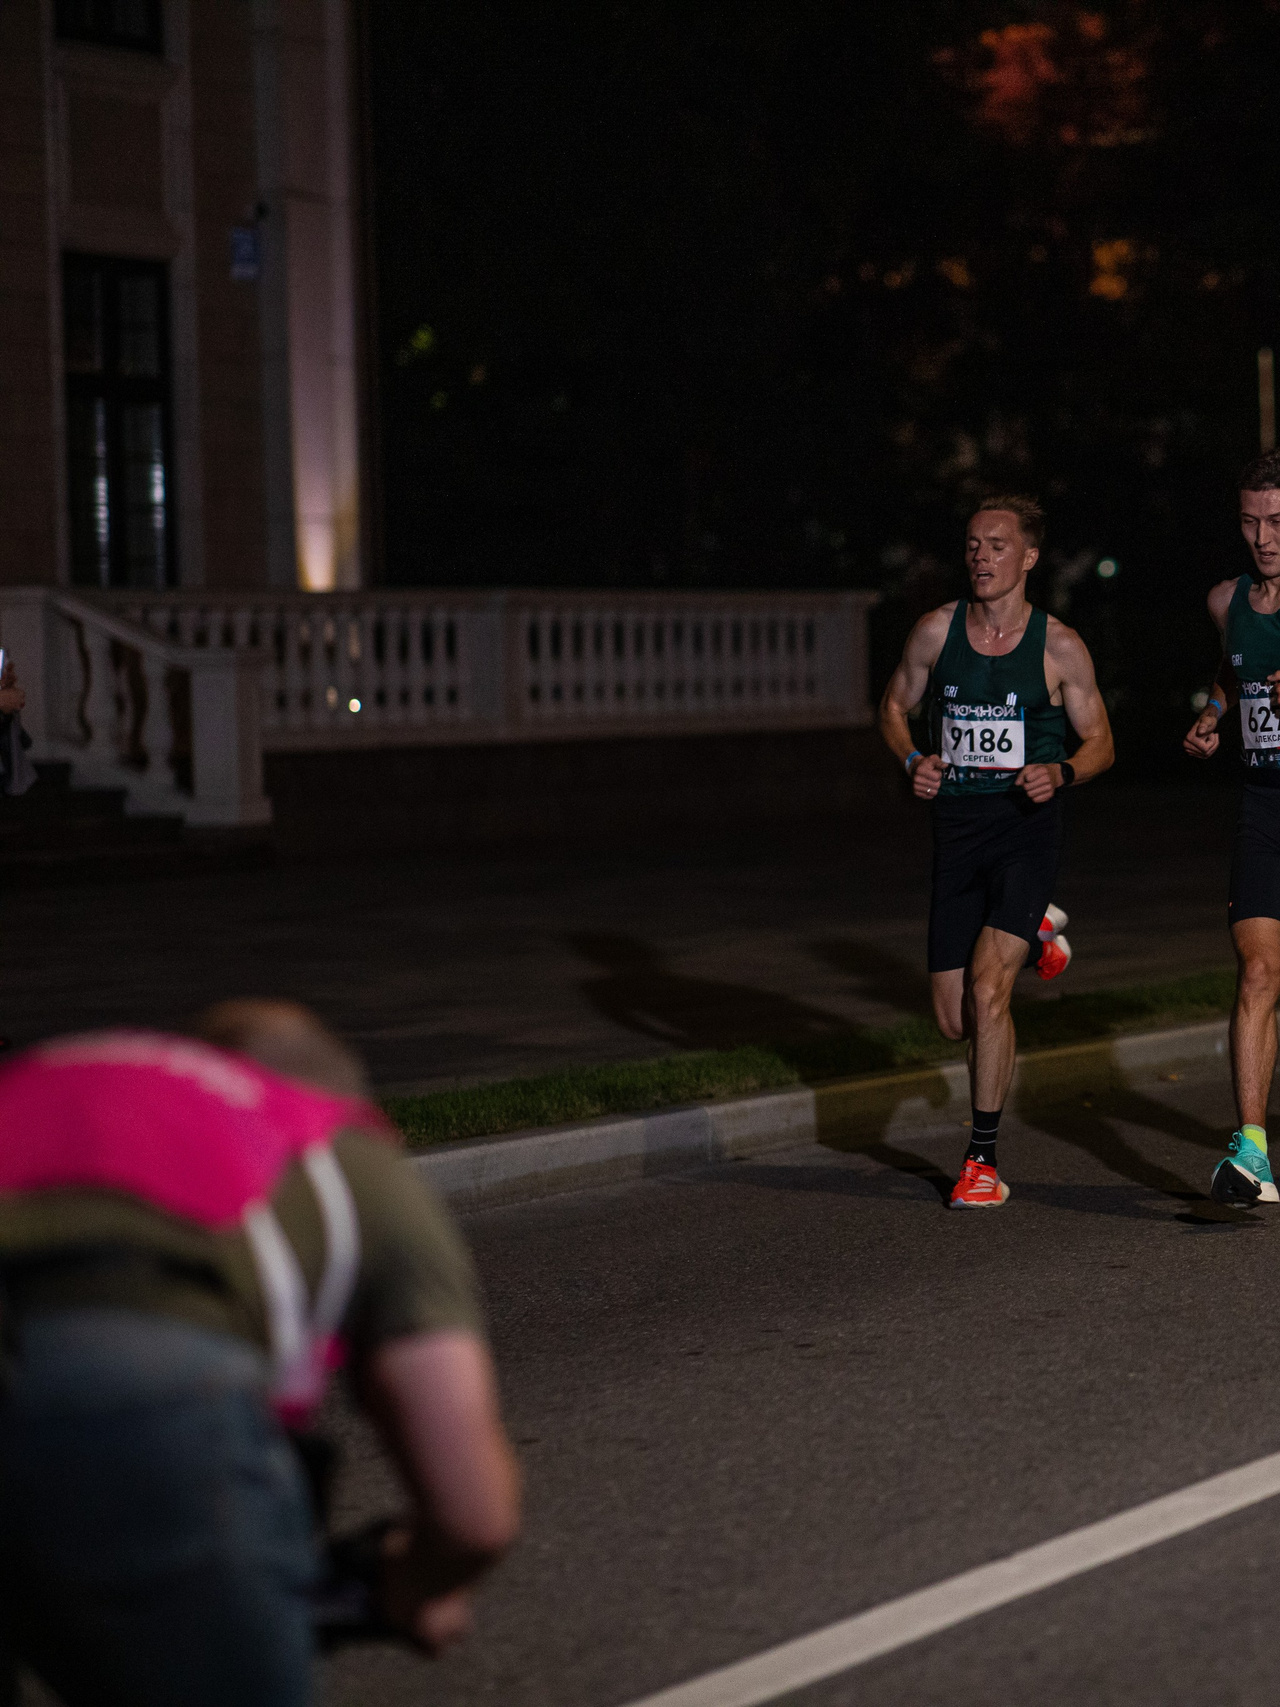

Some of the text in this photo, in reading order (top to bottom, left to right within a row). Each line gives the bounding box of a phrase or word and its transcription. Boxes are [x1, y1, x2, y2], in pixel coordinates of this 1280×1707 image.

[943, 685, 959, 698] GRi
[1242, 681, 1274, 695] НОЧ
[950, 727, 1013, 753] 9186
[962, 754, 995, 763] СЕРГЕЙ
